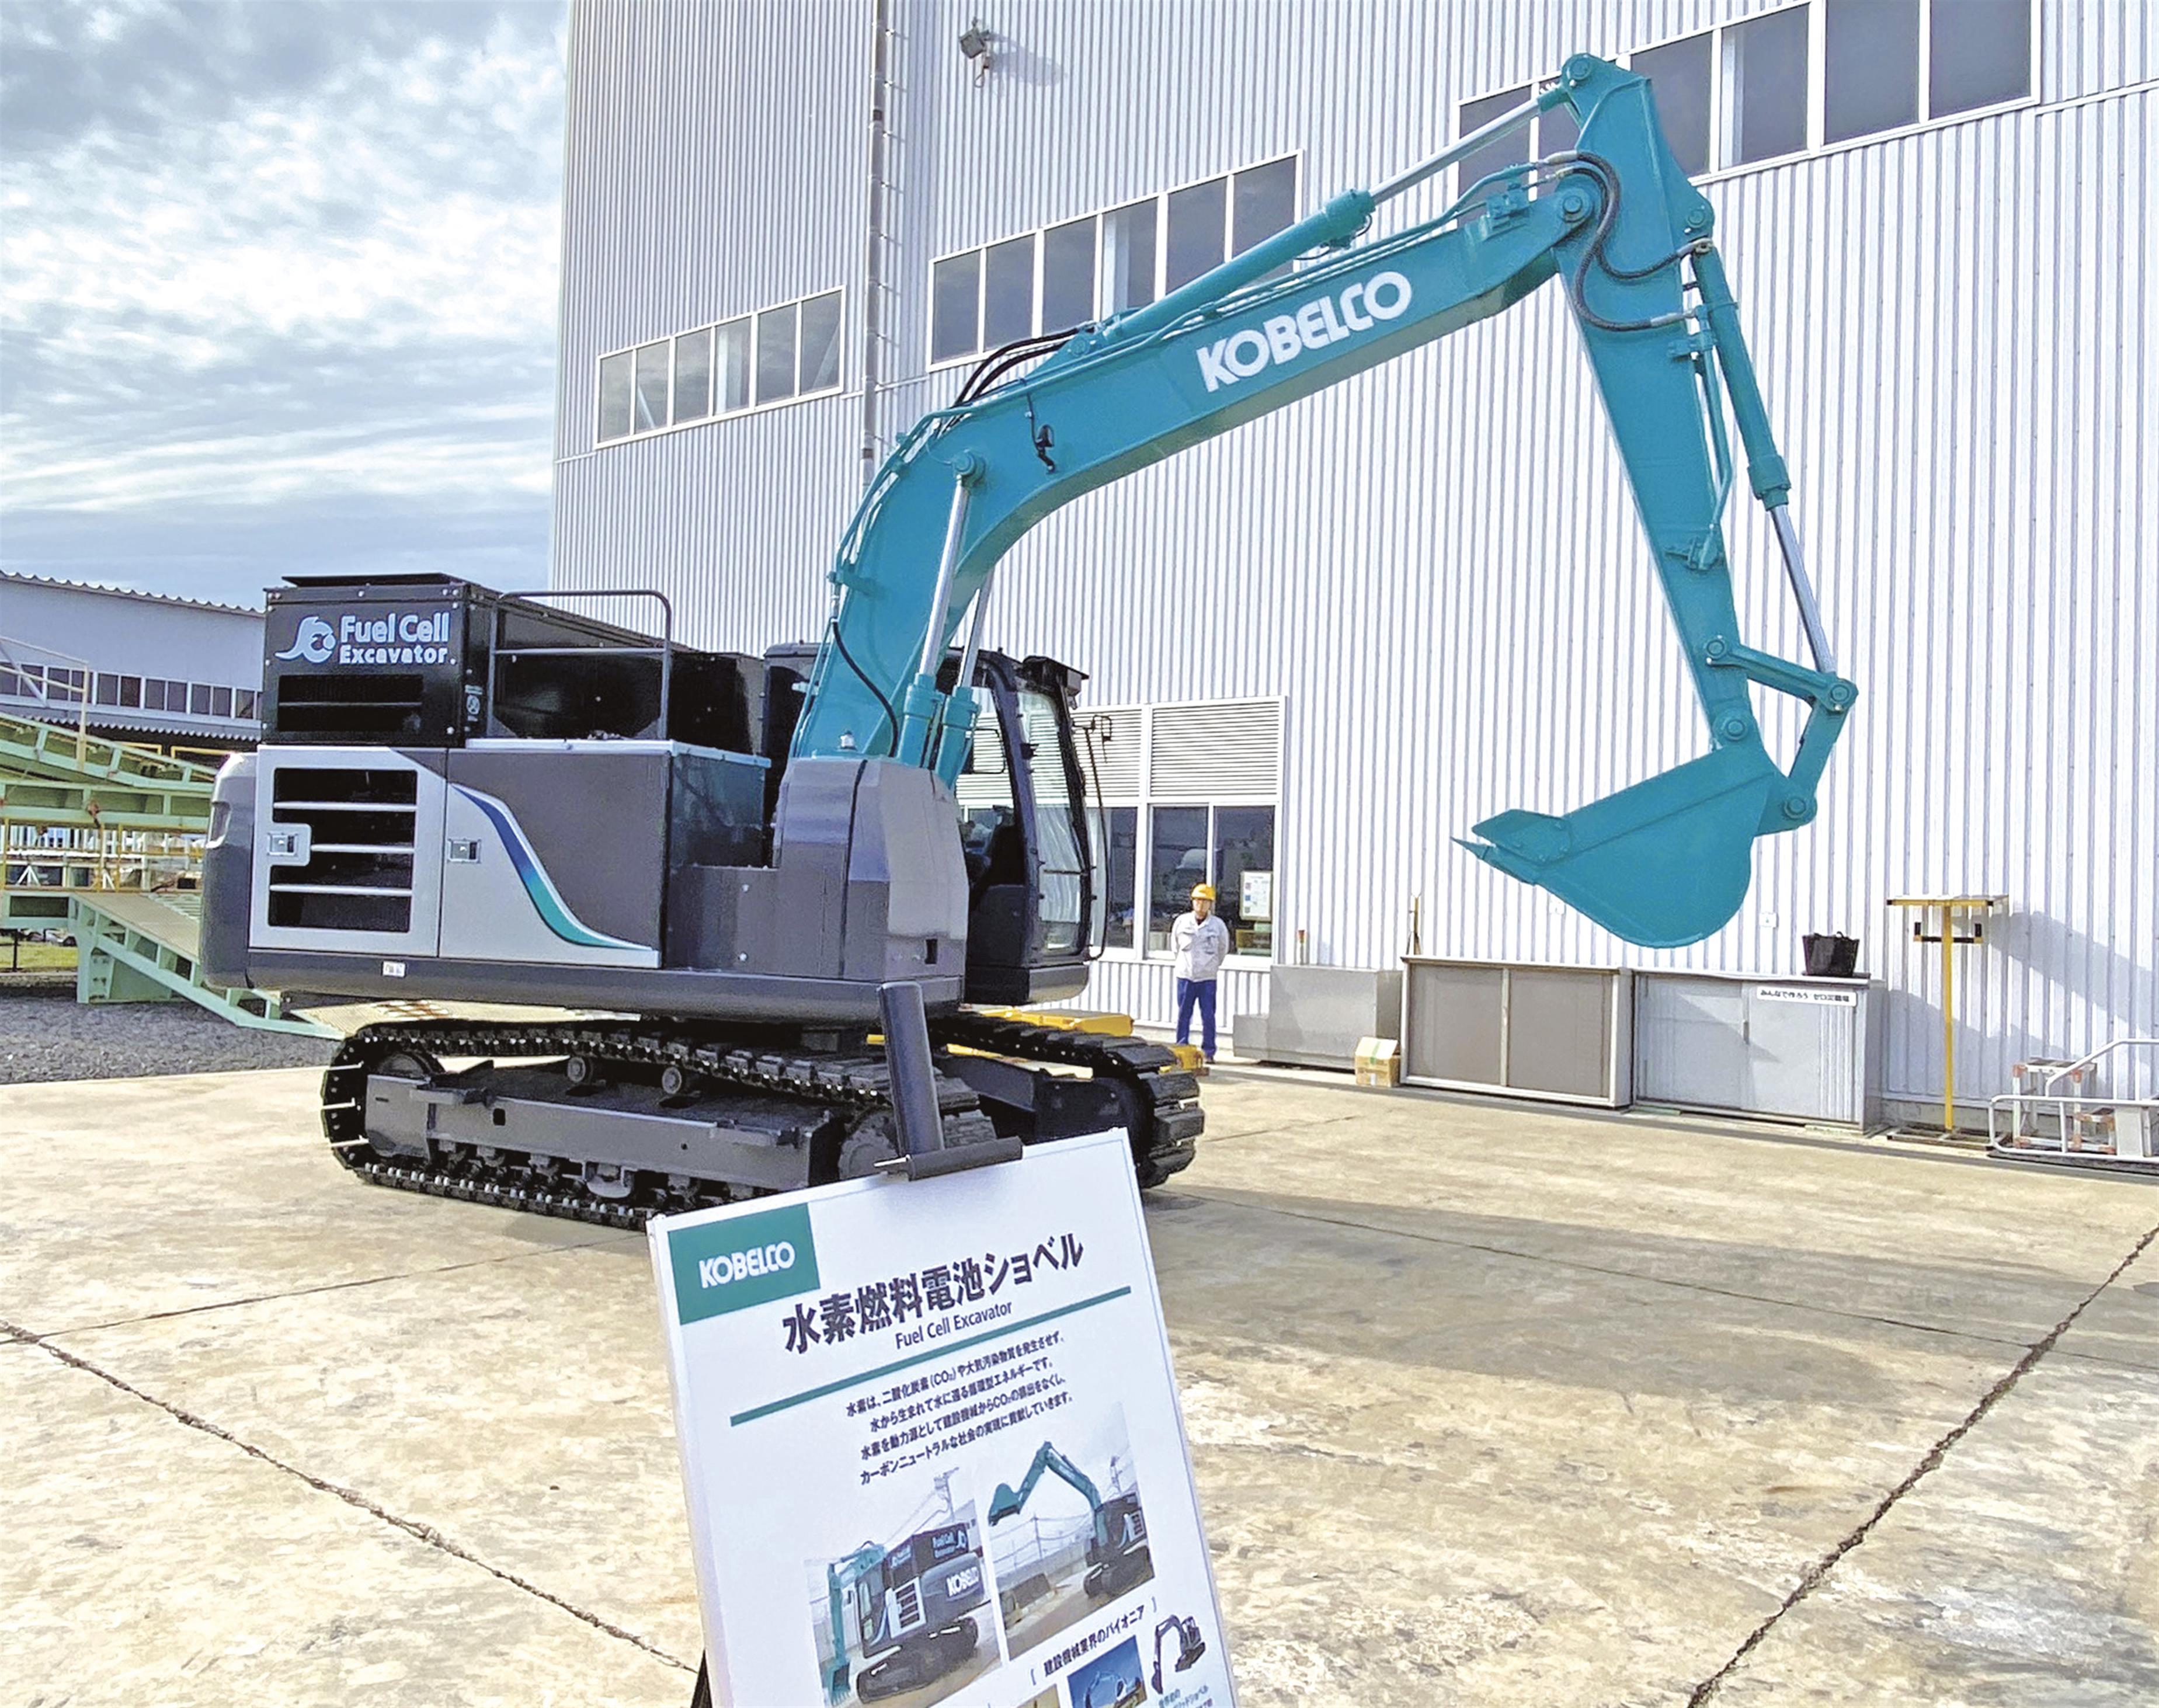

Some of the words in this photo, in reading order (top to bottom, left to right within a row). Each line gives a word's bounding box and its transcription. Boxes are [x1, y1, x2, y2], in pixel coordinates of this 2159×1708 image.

[1196, 271, 1412, 392] KOBELCO
[340, 613, 397, 643] Fuel
[398, 612, 450, 643] Cell
[339, 644, 448, 665] Excavator
[699, 1241, 795, 1289] KOBELCO
[782, 1233, 1084, 1354] 水素燃料電池ショベル
[895, 1325, 924, 1349] Fuel
[927, 1316, 951, 1338] Cell
[953, 1302, 1012, 1330] Excavator
